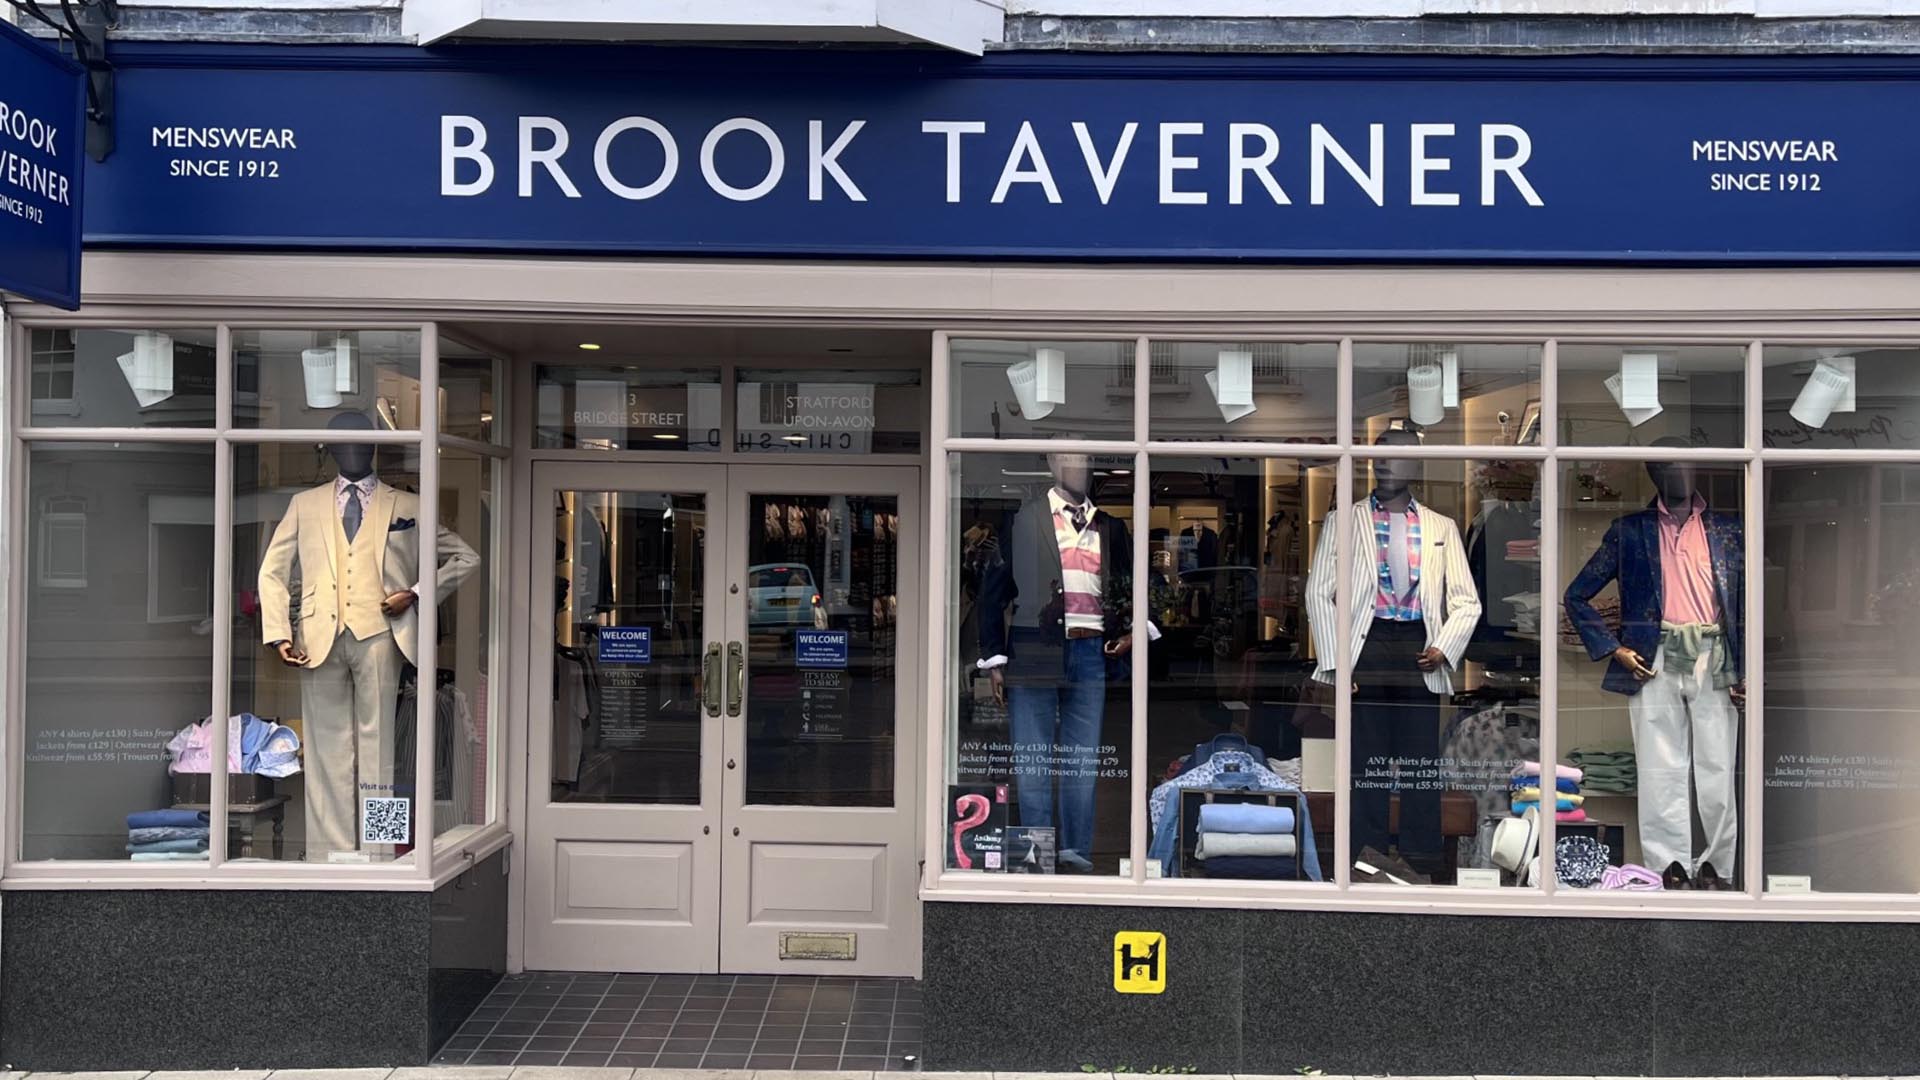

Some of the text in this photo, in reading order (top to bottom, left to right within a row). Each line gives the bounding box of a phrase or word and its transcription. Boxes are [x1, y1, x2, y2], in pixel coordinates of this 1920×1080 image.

[152, 127, 297, 149] MENSWEAR
[1692, 140, 1838, 162] MENSWEAR
[441, 115, 1544, 206] BROOK TAVERNER
[170, 159, 280, 178] SINCE 1912
[1711, 173, 1821, 191] SINCE 1912
[25, 204, 43, 224] 1912
[786, 396, 873, 409] STRATFORD
[574, 411, 684, 426] BRIDGE STREET
[783, 415, 876, 428] UPON-AVON
[602, 631, 647, 640] WELCOME
[799, 635, 845, 644] WELCOME
[605, 671, 644, 679] OPENING
[961, 742, 981, 751] ANY
[989, 742, 1012, 752] shirts
[1013, 743, 1025, 754] for
[1053, 744, 1074, 753] Suits
[1075, 745, 1094, 755] from
[1096, 746, 1117, 754] £199
[122, 753, 158, 762] Trousers
[960, 754, 987, 764] Jackets
[987, 754, 1007, 765] from
[1009, 755, 1030, 764] £129
[1036, 755, 1079, 765] Outerwear
[1081, 757, 1101, 767] from
[1367, 757, 1387, 766] ANY
[1395, 756, 1419, 766] shirts
[1419, 757, 1432, 768] for
[1777, 754, 1798, 764] ANY
[957, 766, 986, 775] nitwear
[987, 765, 1007, 776] from
[1041, 767, 1078, 777] Trousers
[1079, 768, 1099, 778] from
[1100, 769, 1129, 778] £45.95
[1365, 768, 1393, 778] Jackets
[1394, 768, 1414, 779] from
[1416, 769, 1438, 778] £129
[1775, 766, 1804, 777] Jackets
[1804, 767, 1825, 778] from
[360, 783, 377, 791] Visit
[1355, 780, 1393, 789] Knitwear
[1393, 780, 1413, 791] from
[1416, 781, 1444, 790] £55.95
[1451, 782, 1487, 791] Trousers
[1487, 783, 1507, 793] from
[1764, 778, 1802, 788] Knitwear
[1803, 778, 1825, 790] from
[1122, 941, 1159, 981] H
